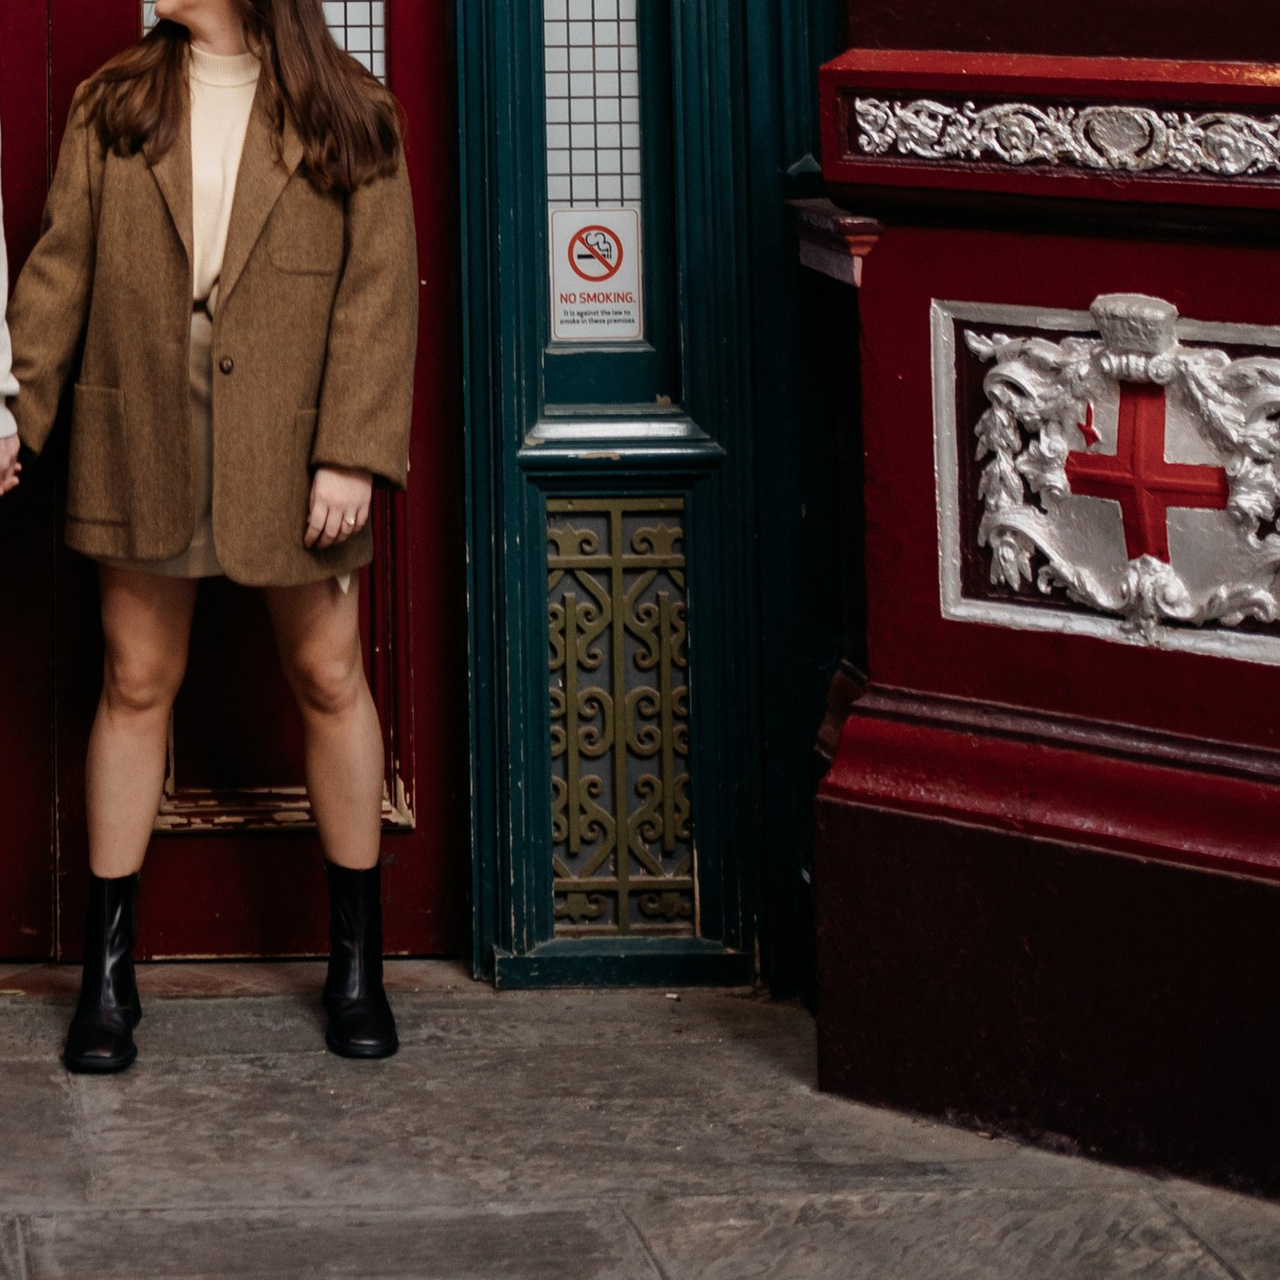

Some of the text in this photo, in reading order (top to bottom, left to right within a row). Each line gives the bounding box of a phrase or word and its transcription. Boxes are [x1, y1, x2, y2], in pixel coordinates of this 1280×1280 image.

[560, 292, 636, 304] NO SMOKING.
[563, 309, 569, 317] It
[570, 309, 575, 317] is
[576, 309, 599, 318] against
[588, 317, 606, 325] these
[607, 317, 635, 325] premises
